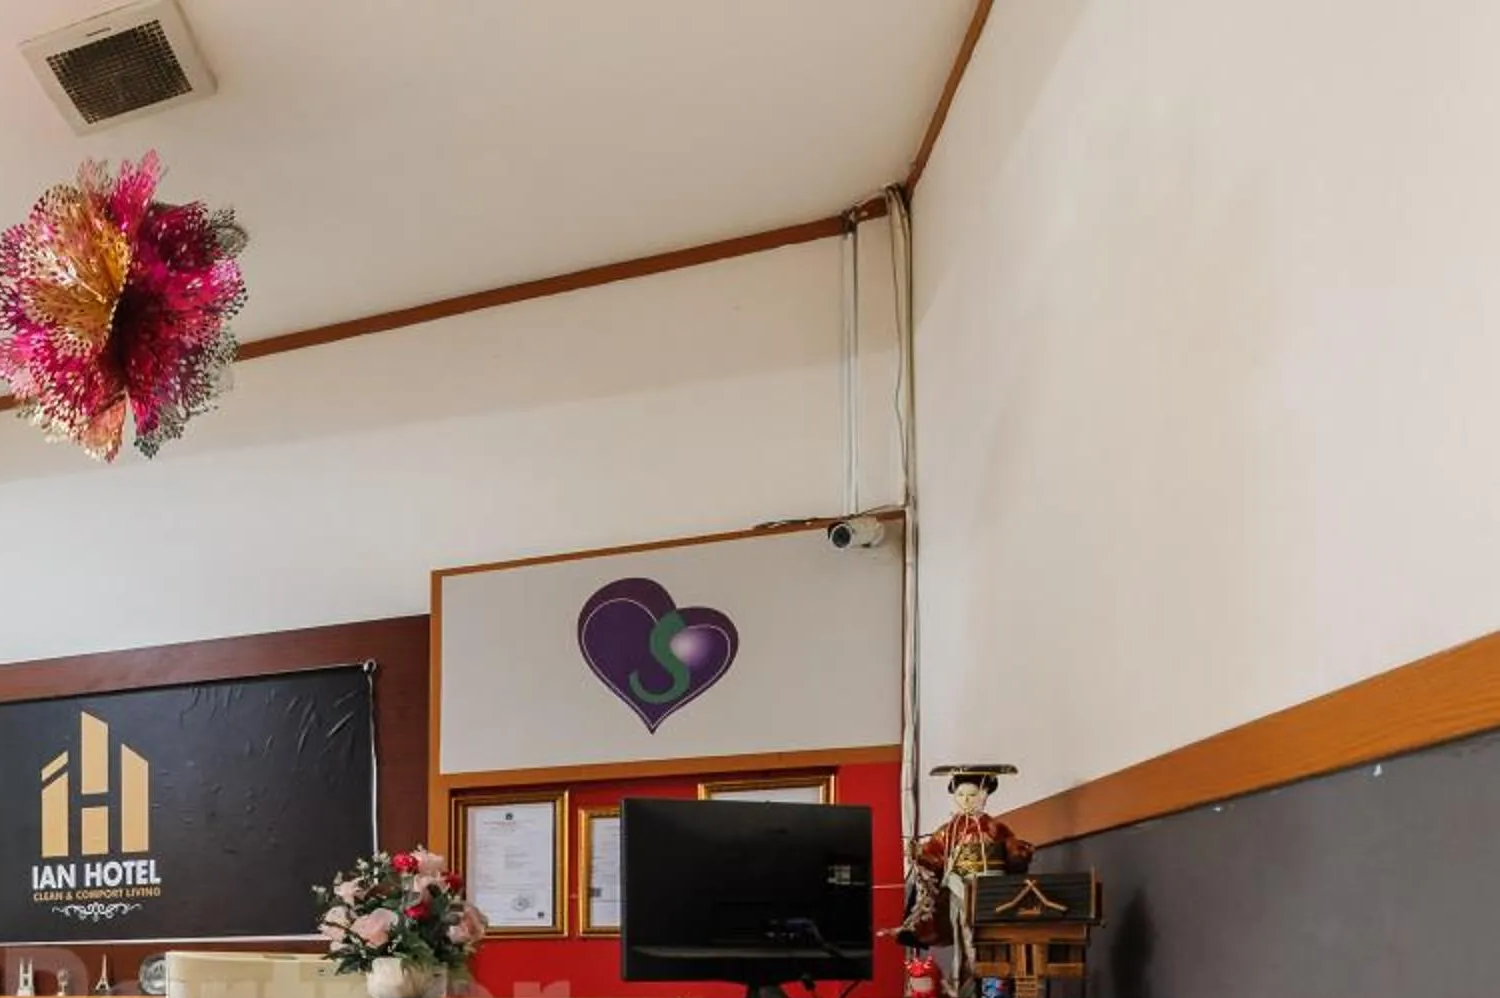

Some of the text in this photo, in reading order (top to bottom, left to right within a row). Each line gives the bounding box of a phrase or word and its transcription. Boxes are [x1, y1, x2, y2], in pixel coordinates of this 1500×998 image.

[32, 859, 162, 890] IAN HOTEL
[33, 889, 63, 902] CLEAN
[125, 885, 162, 898] LIVING
